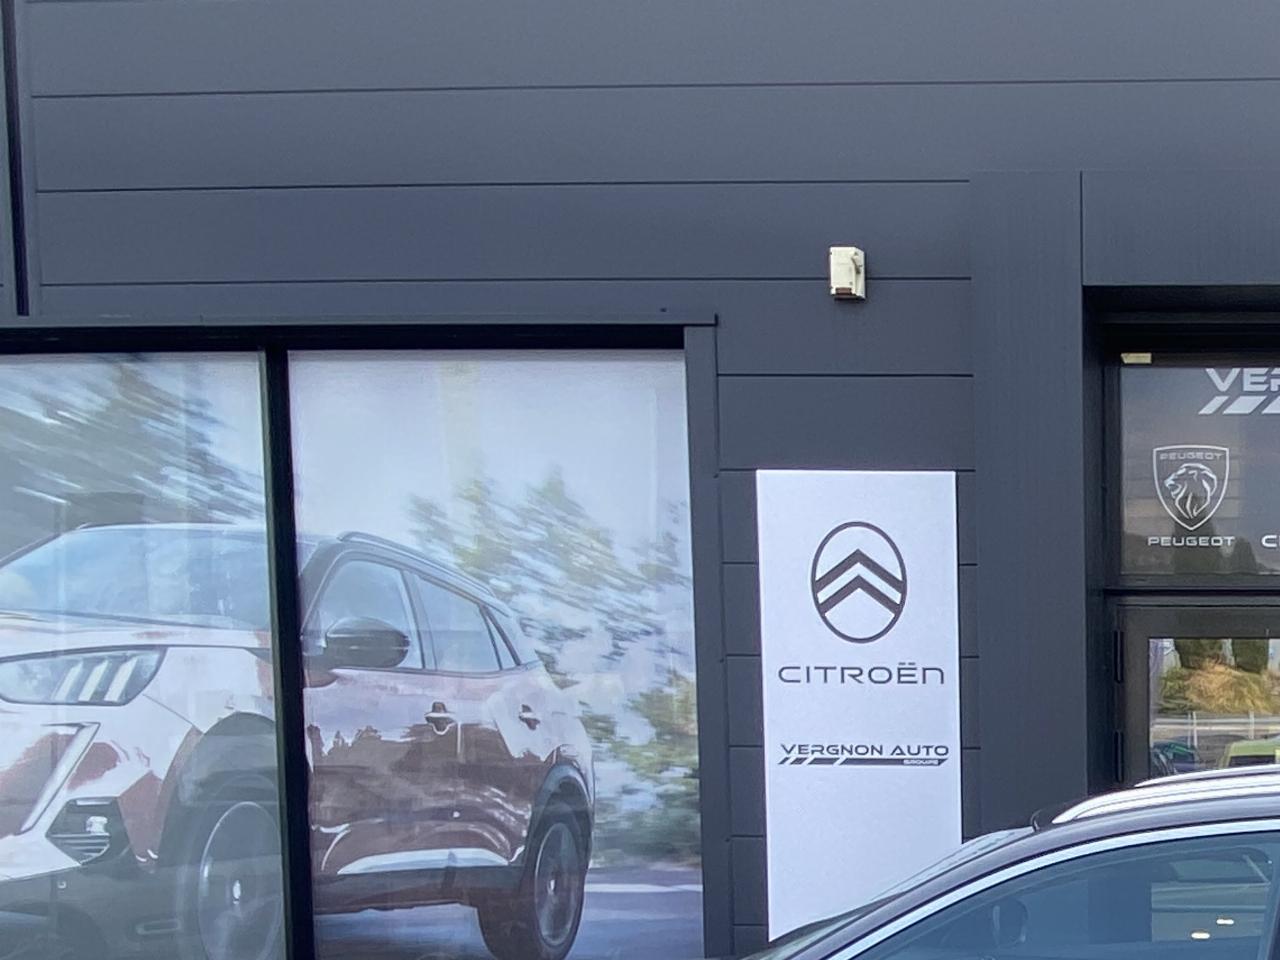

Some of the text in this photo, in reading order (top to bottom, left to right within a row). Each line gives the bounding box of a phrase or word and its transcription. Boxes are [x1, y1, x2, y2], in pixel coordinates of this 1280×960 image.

[1159, 452, 1223, 461] PEUGEOT
[1147, 536, 1235, 547] PEUGEOT
[778, 662, 945, 684] CITROËN
[781, 744, 949, 756] VERGNON AUTO
